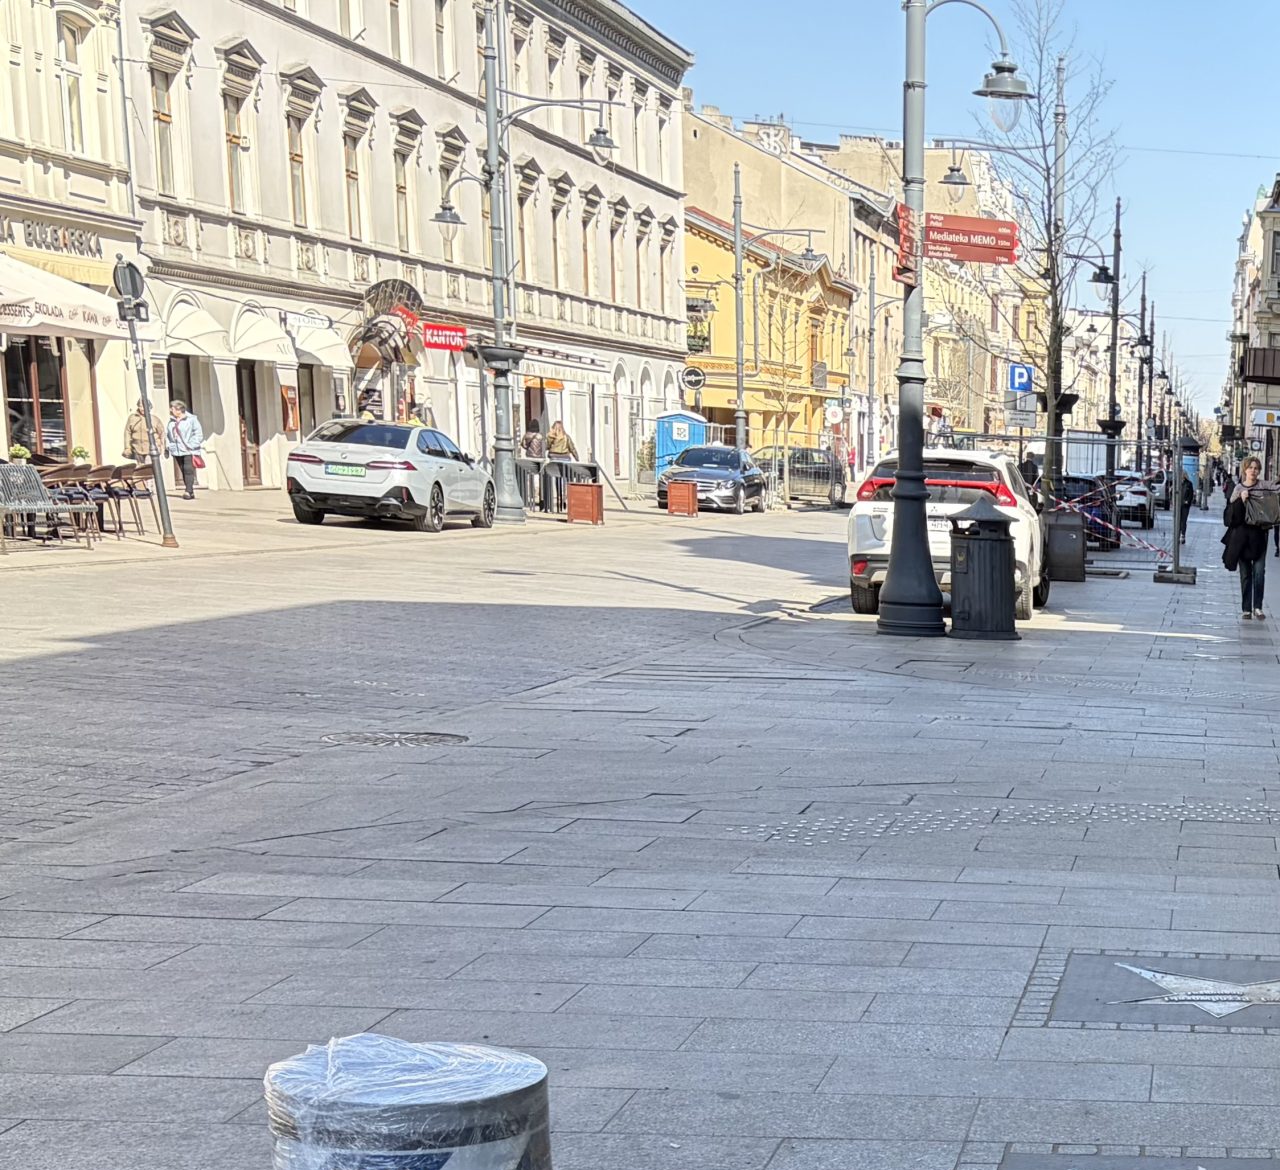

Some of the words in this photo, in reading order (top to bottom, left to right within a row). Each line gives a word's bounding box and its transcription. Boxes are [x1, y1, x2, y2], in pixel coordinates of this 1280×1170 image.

[929, 231, 968, 243] Mediateka
[970, 234, 996, 246] MEMO
[425, 328, 465, 347] KANTOR
[1014, 367, 1029, 388] P
